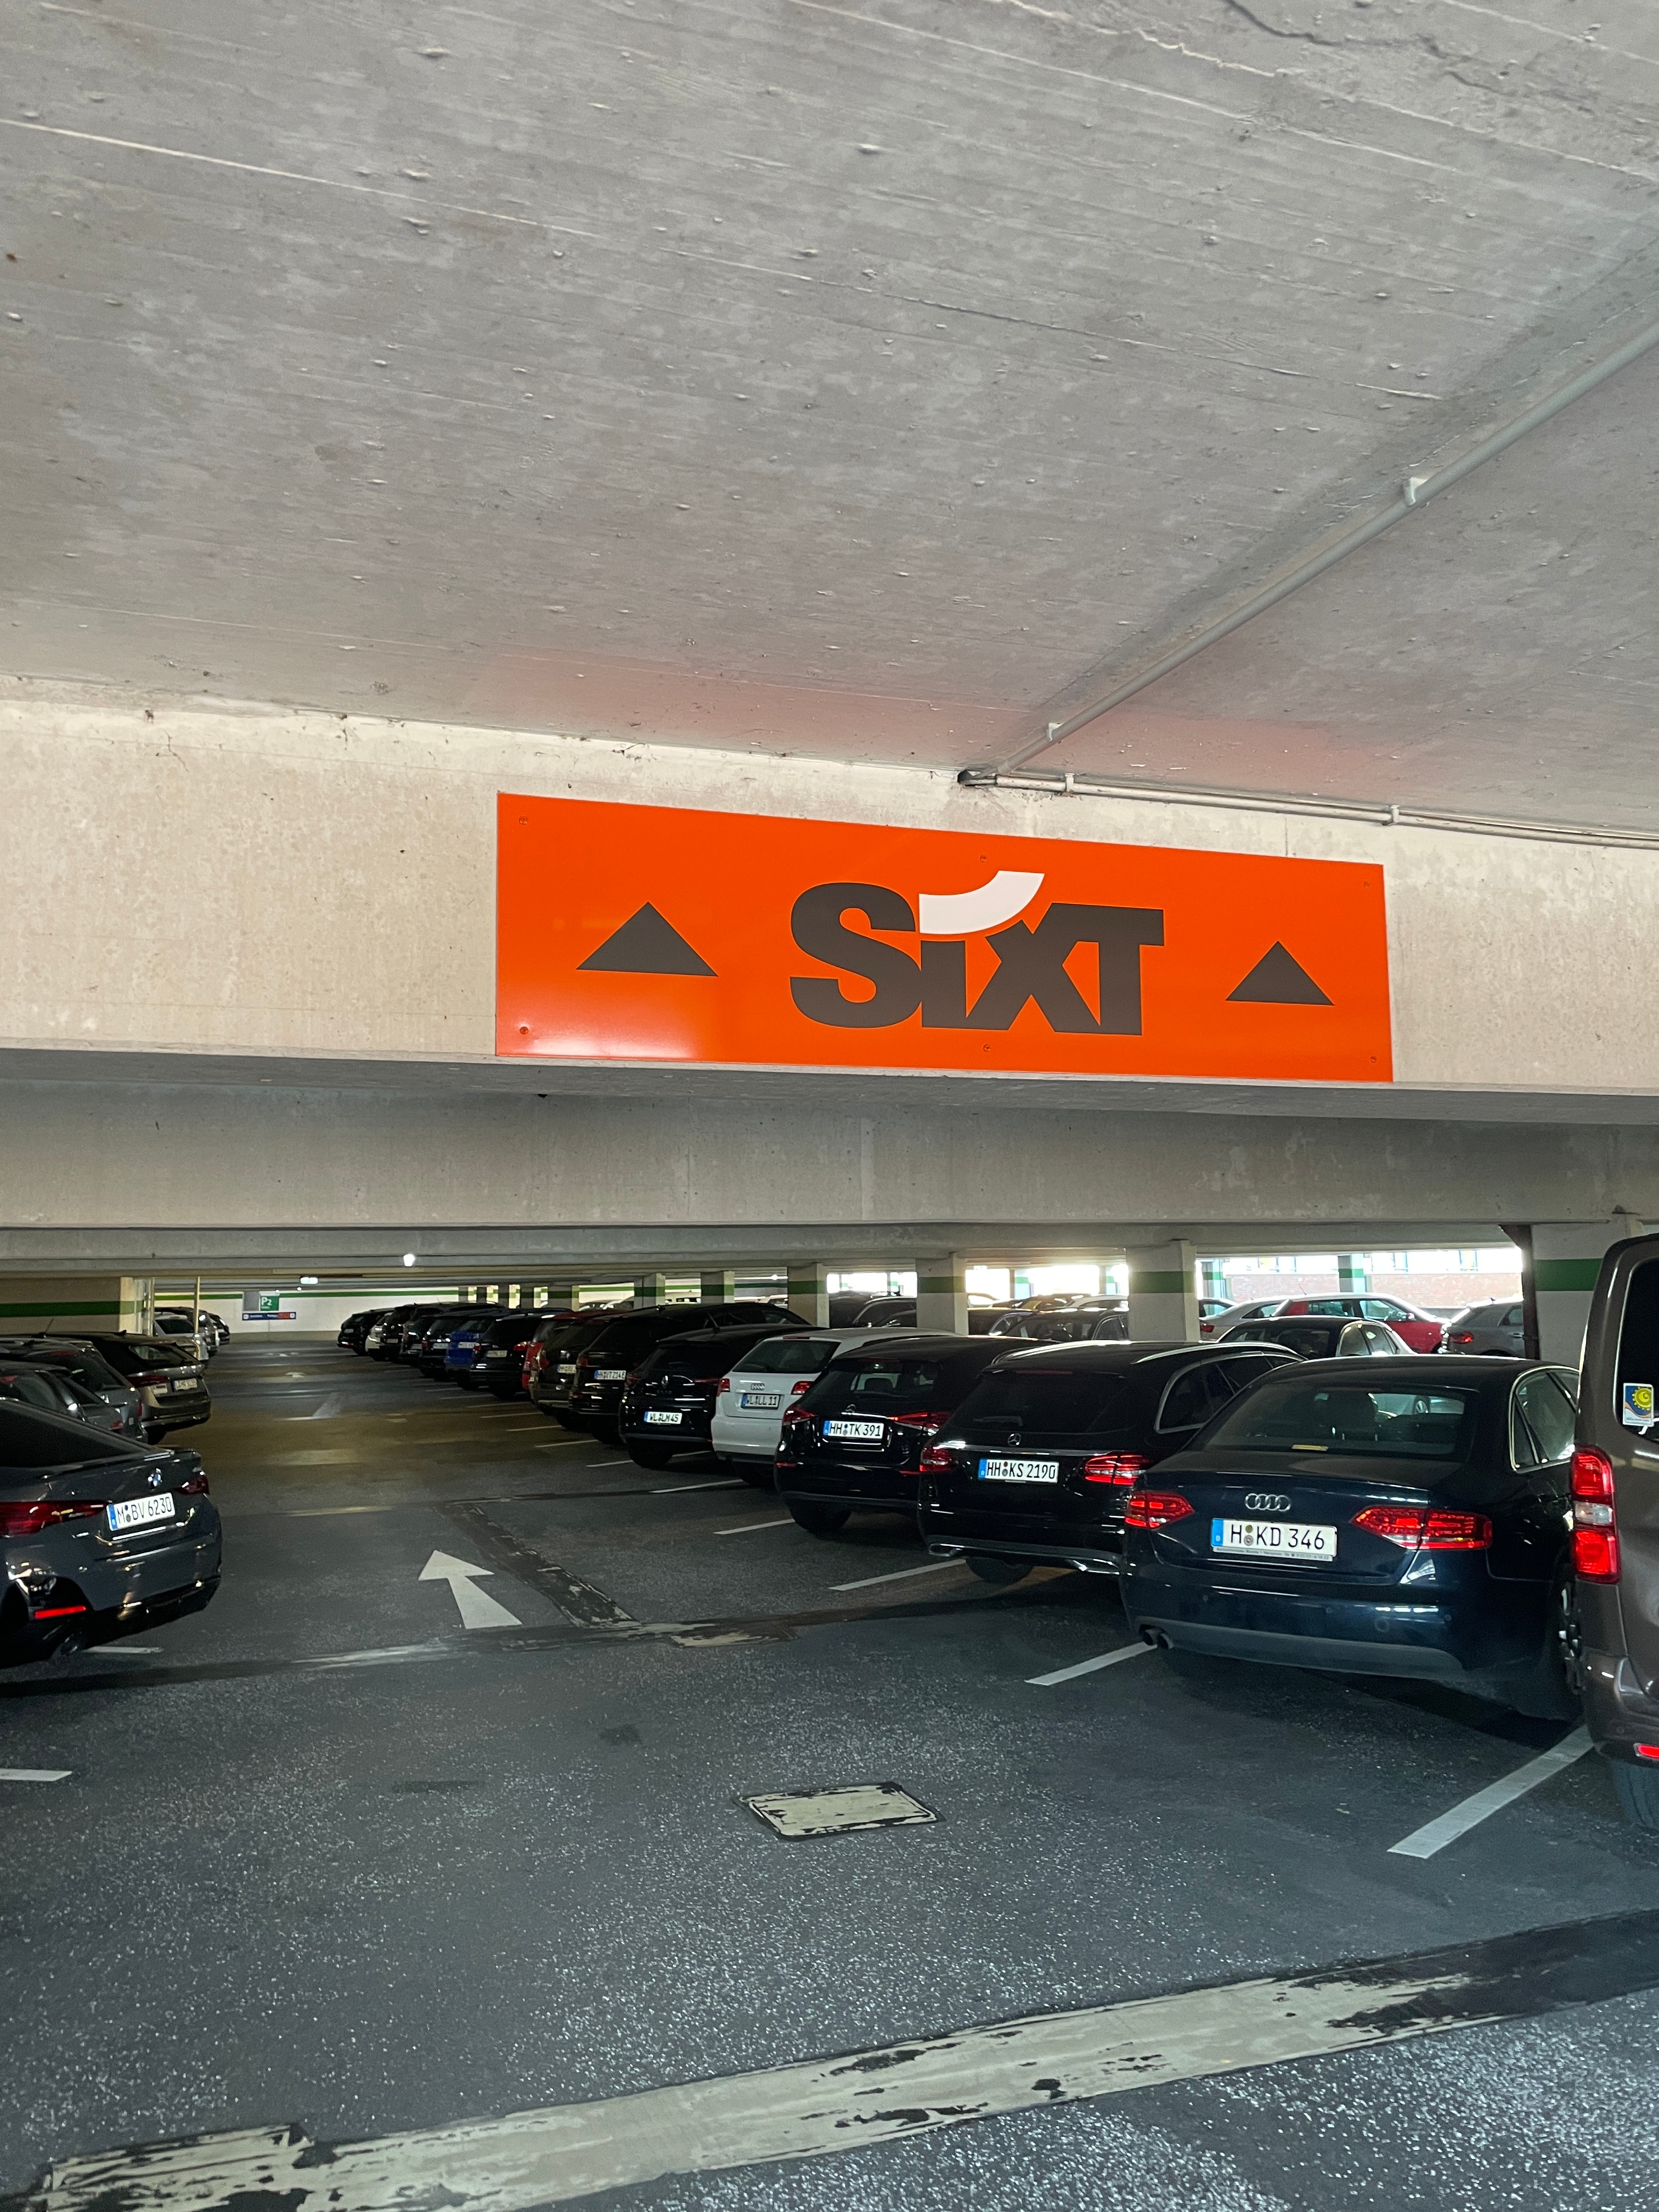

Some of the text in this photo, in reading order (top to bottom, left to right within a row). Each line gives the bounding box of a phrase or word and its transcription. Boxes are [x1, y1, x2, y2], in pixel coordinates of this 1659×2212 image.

[829, 1423, 881, 1436] HH TK 391
[987, 1462, 1056, 1479] HH KS 2190
[117, 1497, 172, 1525] M BV 6230
[1231, 1524, 1325, 1550] H KD 346
